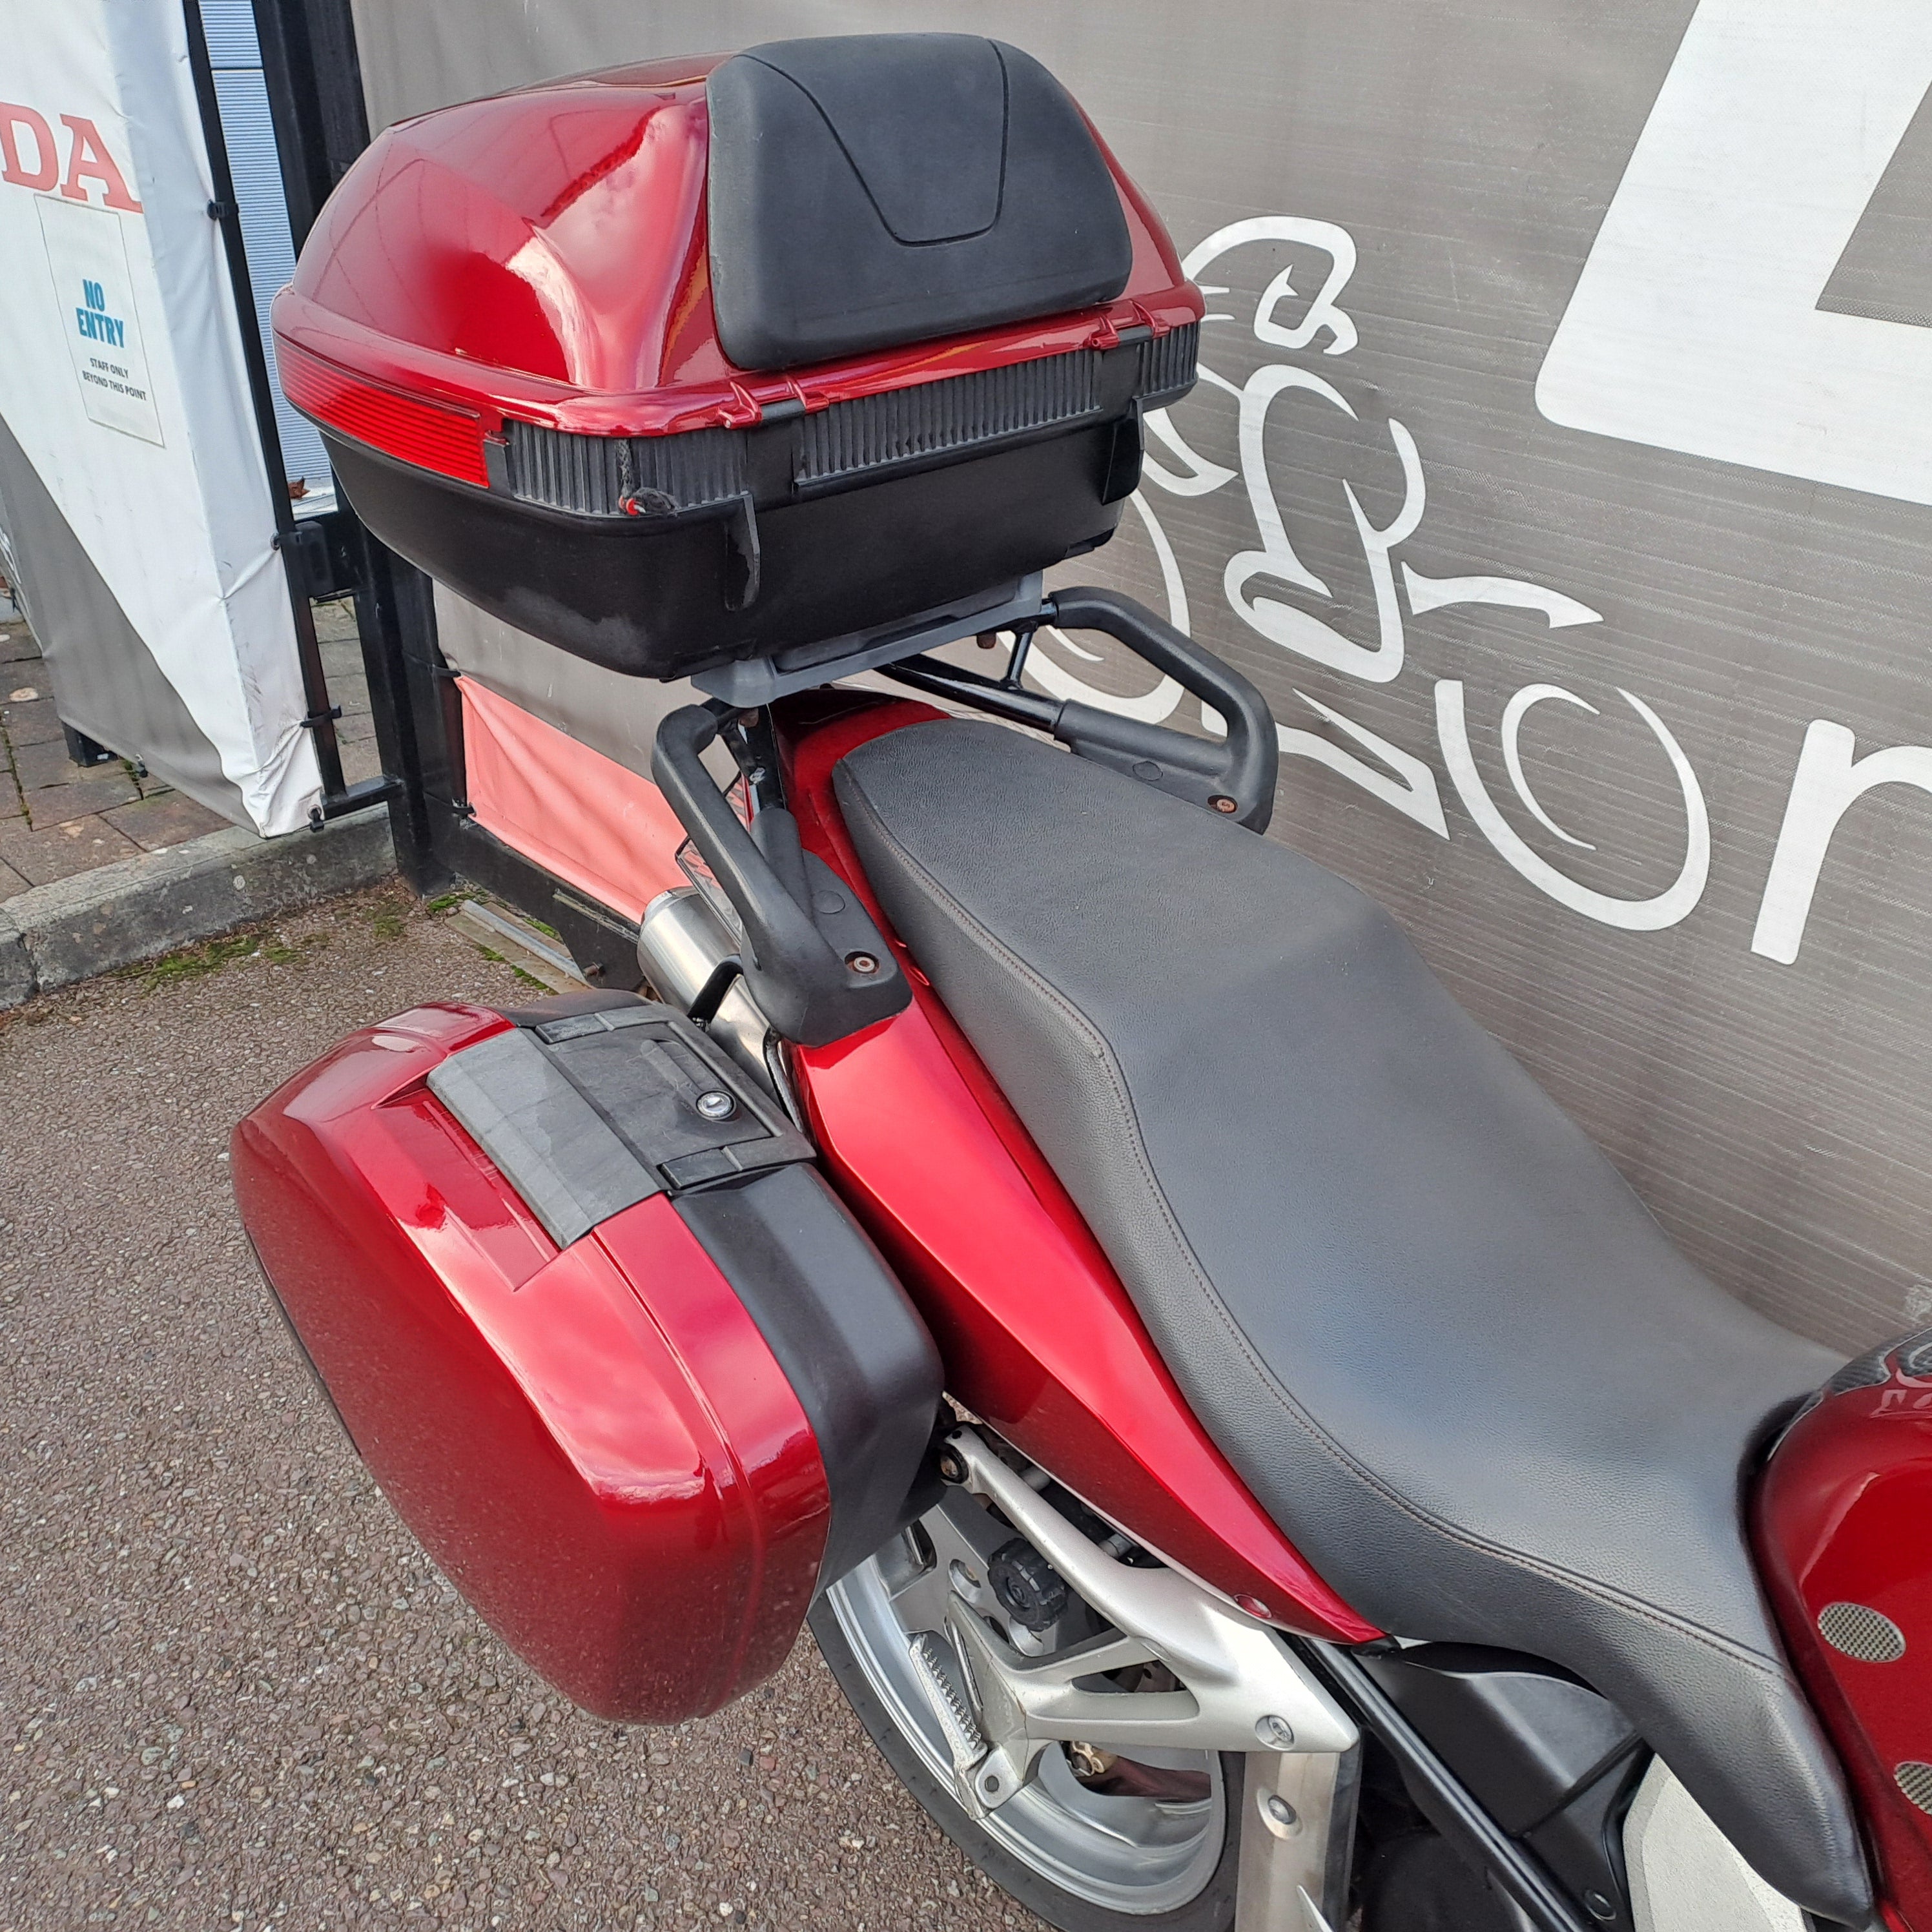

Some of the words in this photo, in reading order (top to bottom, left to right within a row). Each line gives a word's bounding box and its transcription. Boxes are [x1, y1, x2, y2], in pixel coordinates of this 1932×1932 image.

[0, 101, 144, 214] DA
[82, 279, 105, 312] NO
[76, 307, 124, 348] ENTRY
[90, 358, 108, 372] STAFF
[110, 364, 128, 378] ONLY
[82, 370, 108, 387] BEYOND
[108, 380, 124, 393] THIS
[125, 385, 146, 400] POINT
